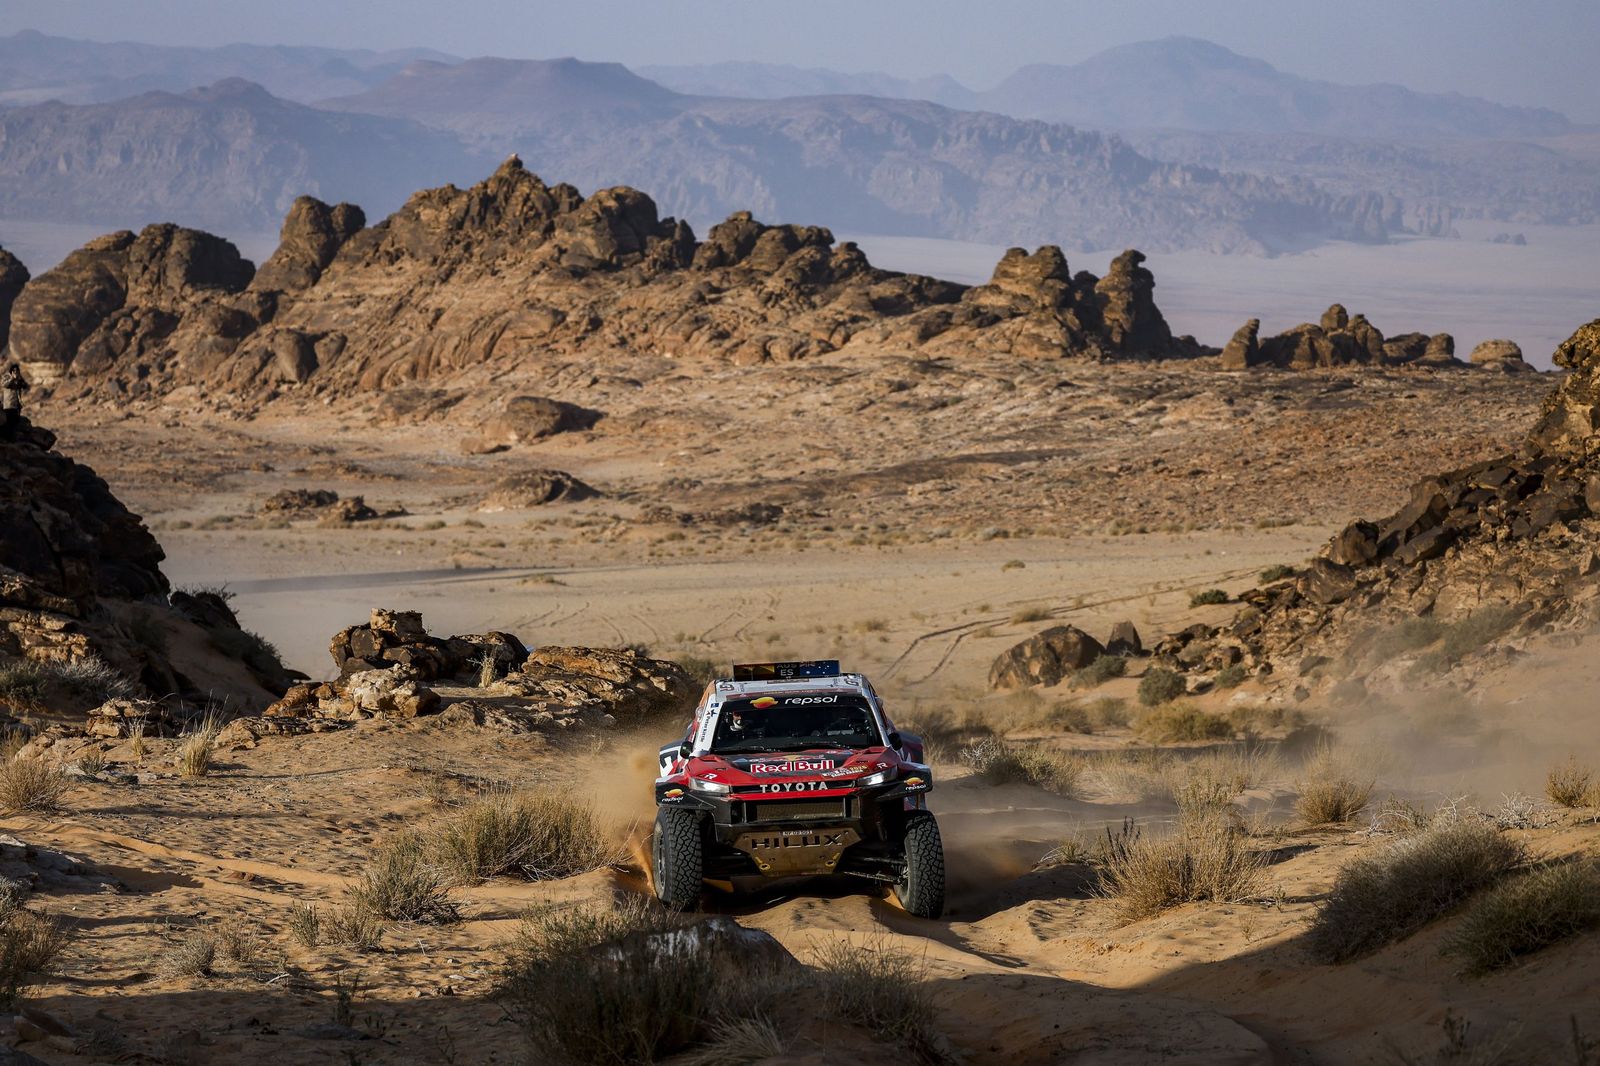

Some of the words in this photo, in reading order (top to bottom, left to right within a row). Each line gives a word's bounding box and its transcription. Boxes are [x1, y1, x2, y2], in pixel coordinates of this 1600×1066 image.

[780, 668, 794, 677] ES
[784, 695, 838, 706] repsol
[750, 761, 793, 774] Red
[793, 759, 834, 772] Bull
[760, 781, 828, 794] TOYOTA
[905, 783, 926, 791] repsol
[751, 834, 842, 849] HILUX
